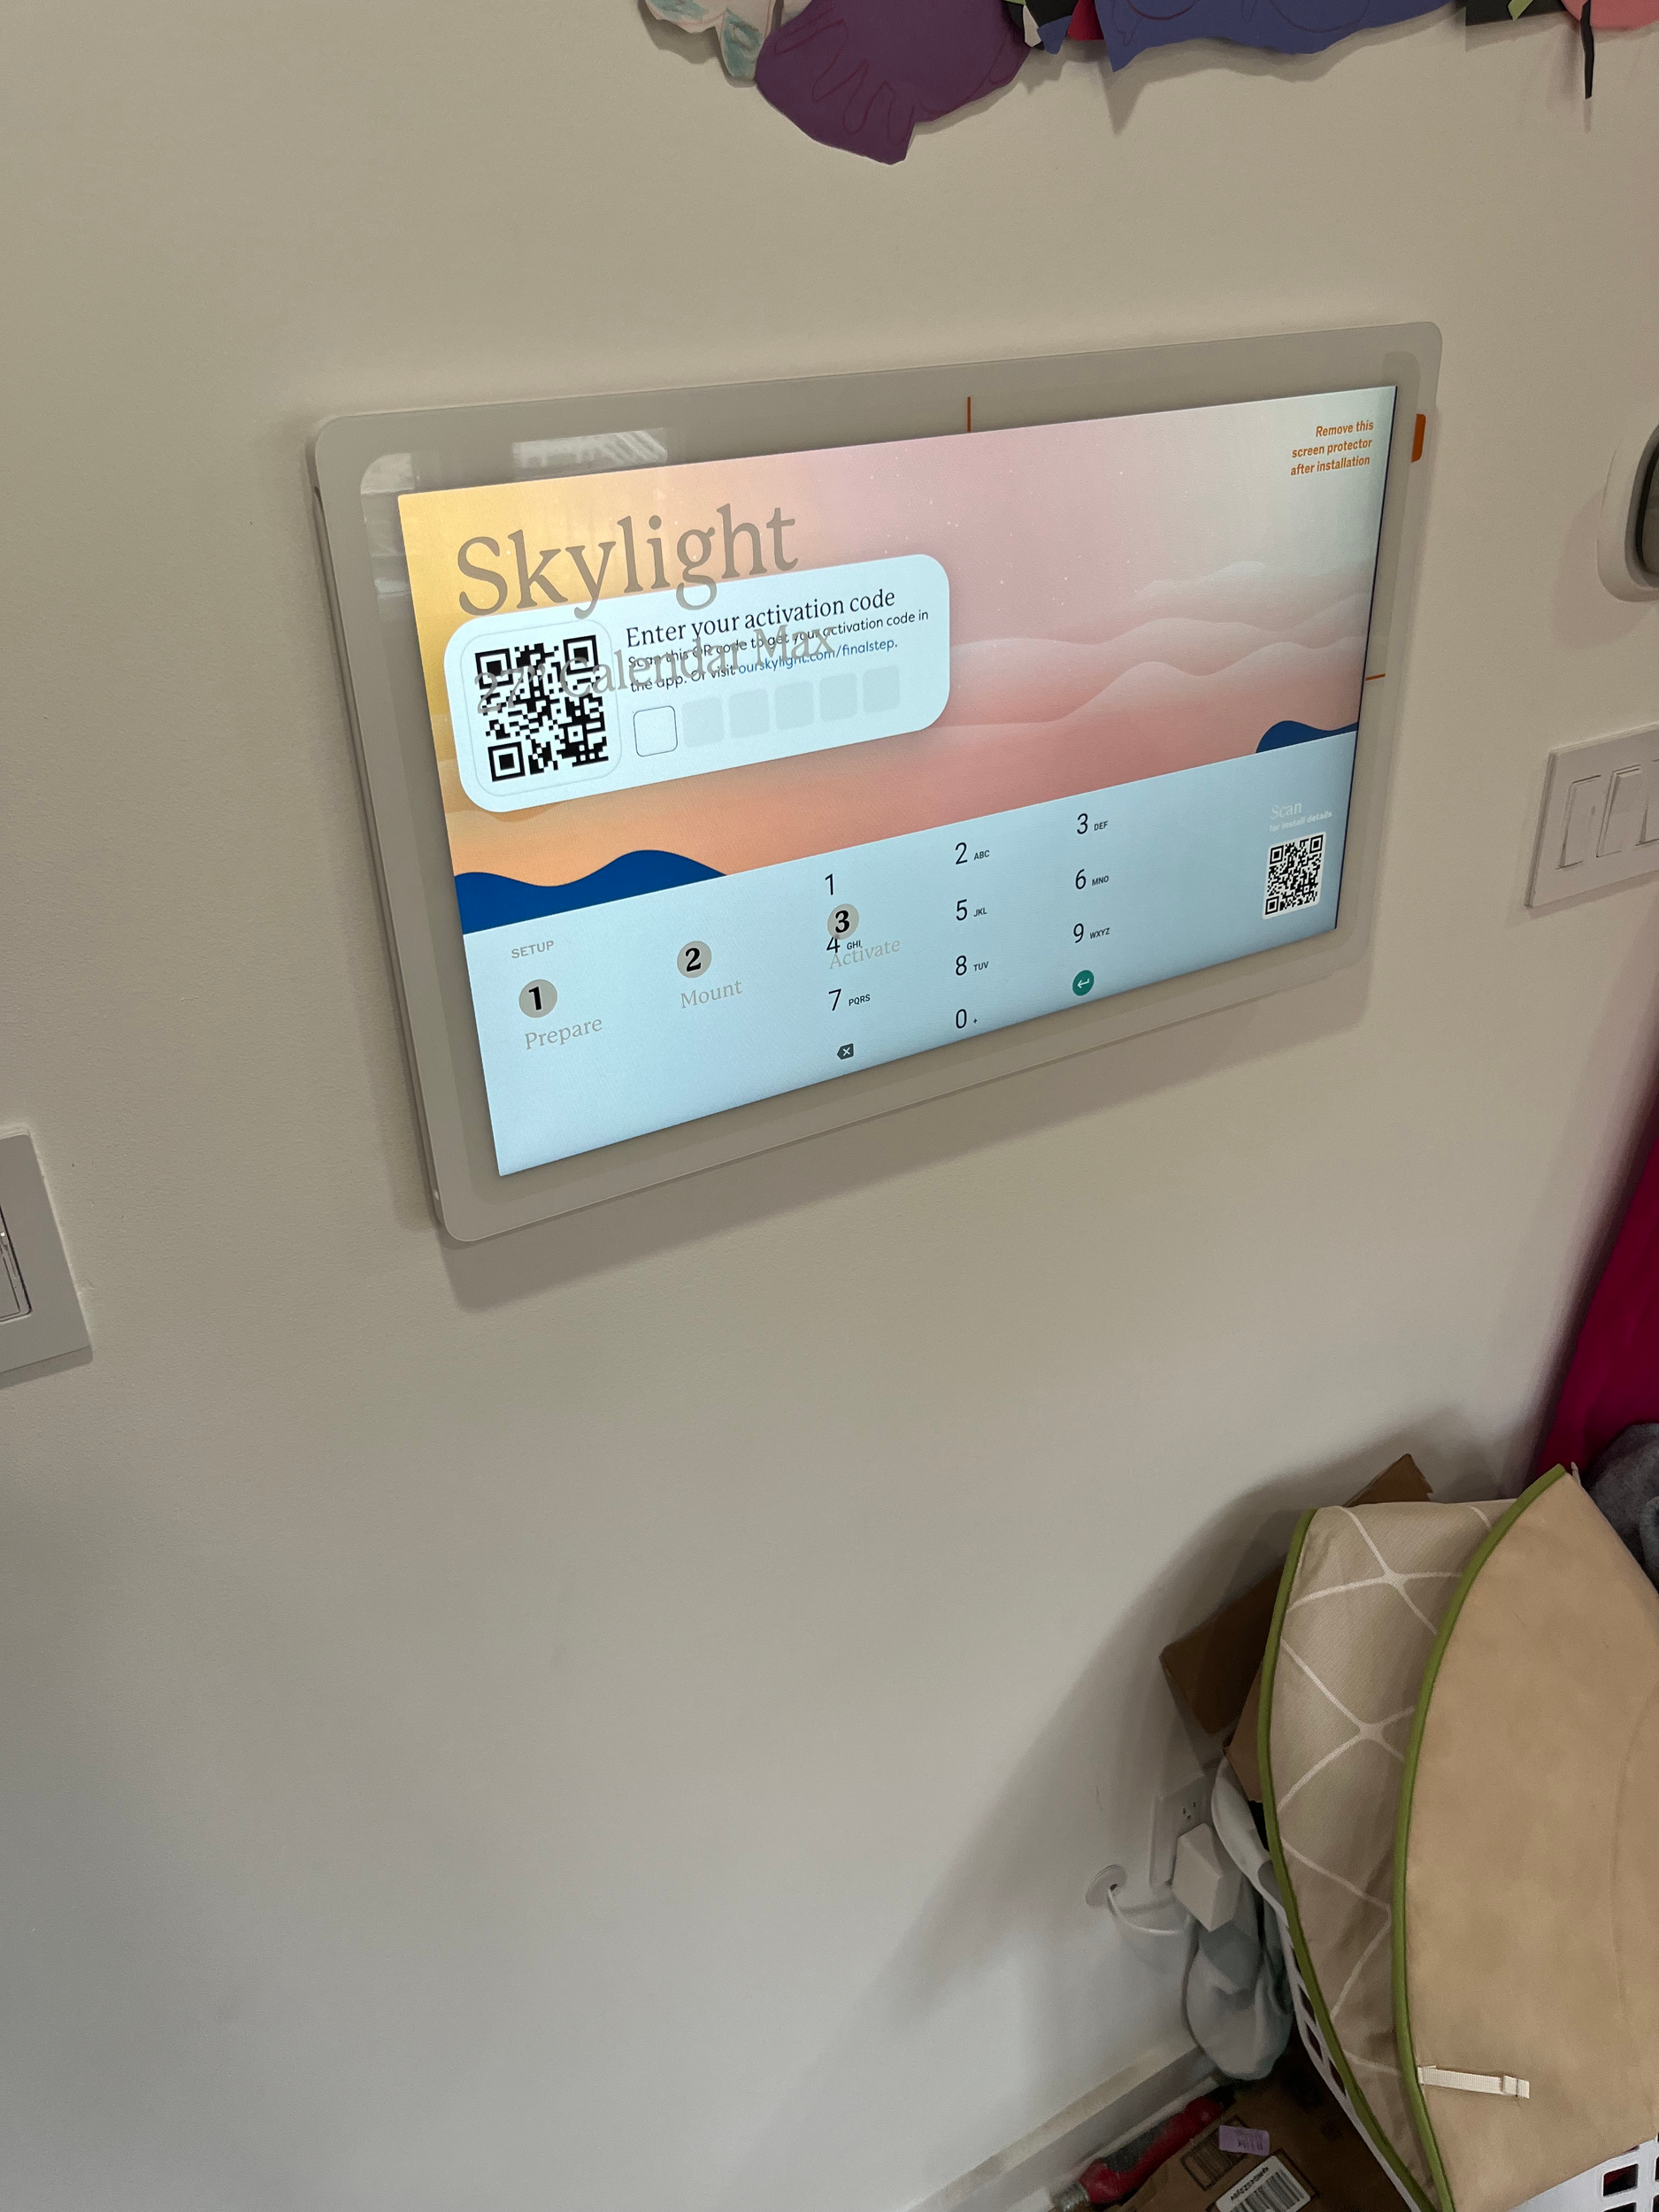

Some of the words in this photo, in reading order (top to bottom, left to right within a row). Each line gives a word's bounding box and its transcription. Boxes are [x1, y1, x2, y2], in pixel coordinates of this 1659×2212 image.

[1316, 424, 1353, 437] Remove
[1356, 419, 1373, 432] this
[1292, 446, 1325, 458] screen
[1327, 439, 1372, 456] protector
[1290, 462, 1315, 476] after
[1317, 456, 1371, 472] installation
[457, 503, 798, 618] Skylight
[626, 624, 687, 648] Enter
[691, 616, 740, 639] your
[745, 599, 845, 629] activation
[849, 588, 895, 612] code
[665, 649, 688, 664] this
[717, 640, 748, 654] code
[751, 636, 764, 649] to
[767, 633, 789, 649] get
[794, 626, 818, 645] your
[823, 618, 883, 637] activation
[887, 611, 915, 626] code
[918, 610, 929, 621] in
[560, 637, 748, 697] Calendar
[754, 625, 834, 666] Max
[710, 664, 736, 679] visit
[738, 639, 898, 673] ourskylight.com/finalstep.
[1269, 824, 1279, 833] for
[1282, 817, 1306, 830] install
[1307, 810, 1333, 823] details
[1270, 803, 1302, 820] Scan
[1077, 813, 1088, 834] 3
[1094, 820, 1109, 832] DEF
[955, 841, 967, 864] 2
[973, 849, 990, 861] ABC
[825, 873, 834, 895] 1
[1075, 869, 1087, 890] 6
[1092, 874, 1110, 887] MNO
[834, 910, 850, 933] 3
[956, 900, 967, 921] 5
[973, 906, 987, 918] JKL
[826, 934, 841, 953] 4
[847, 940, 861, 950] GHI
[1073, 923, 1085, 943] 9
[1089, 927, 1110, 940] WXYZ
[511, 940, 555, 959] SETUP
[686, 948, 703, 972] 2
[829, 941, 901, 970] Activate
[956, 956, 967, 976] 8
[973, 961, 989, 972] TUV
[528, 987, 542, 1010] 1
[680, 979, 743, 1009] Mount
[828, 988, 841, 1011] 7
[849, 994, 871, 1006] PQRS
[956, 1009, 967, 1028] 0
[524, 1018, 603, 1049] Prepare
